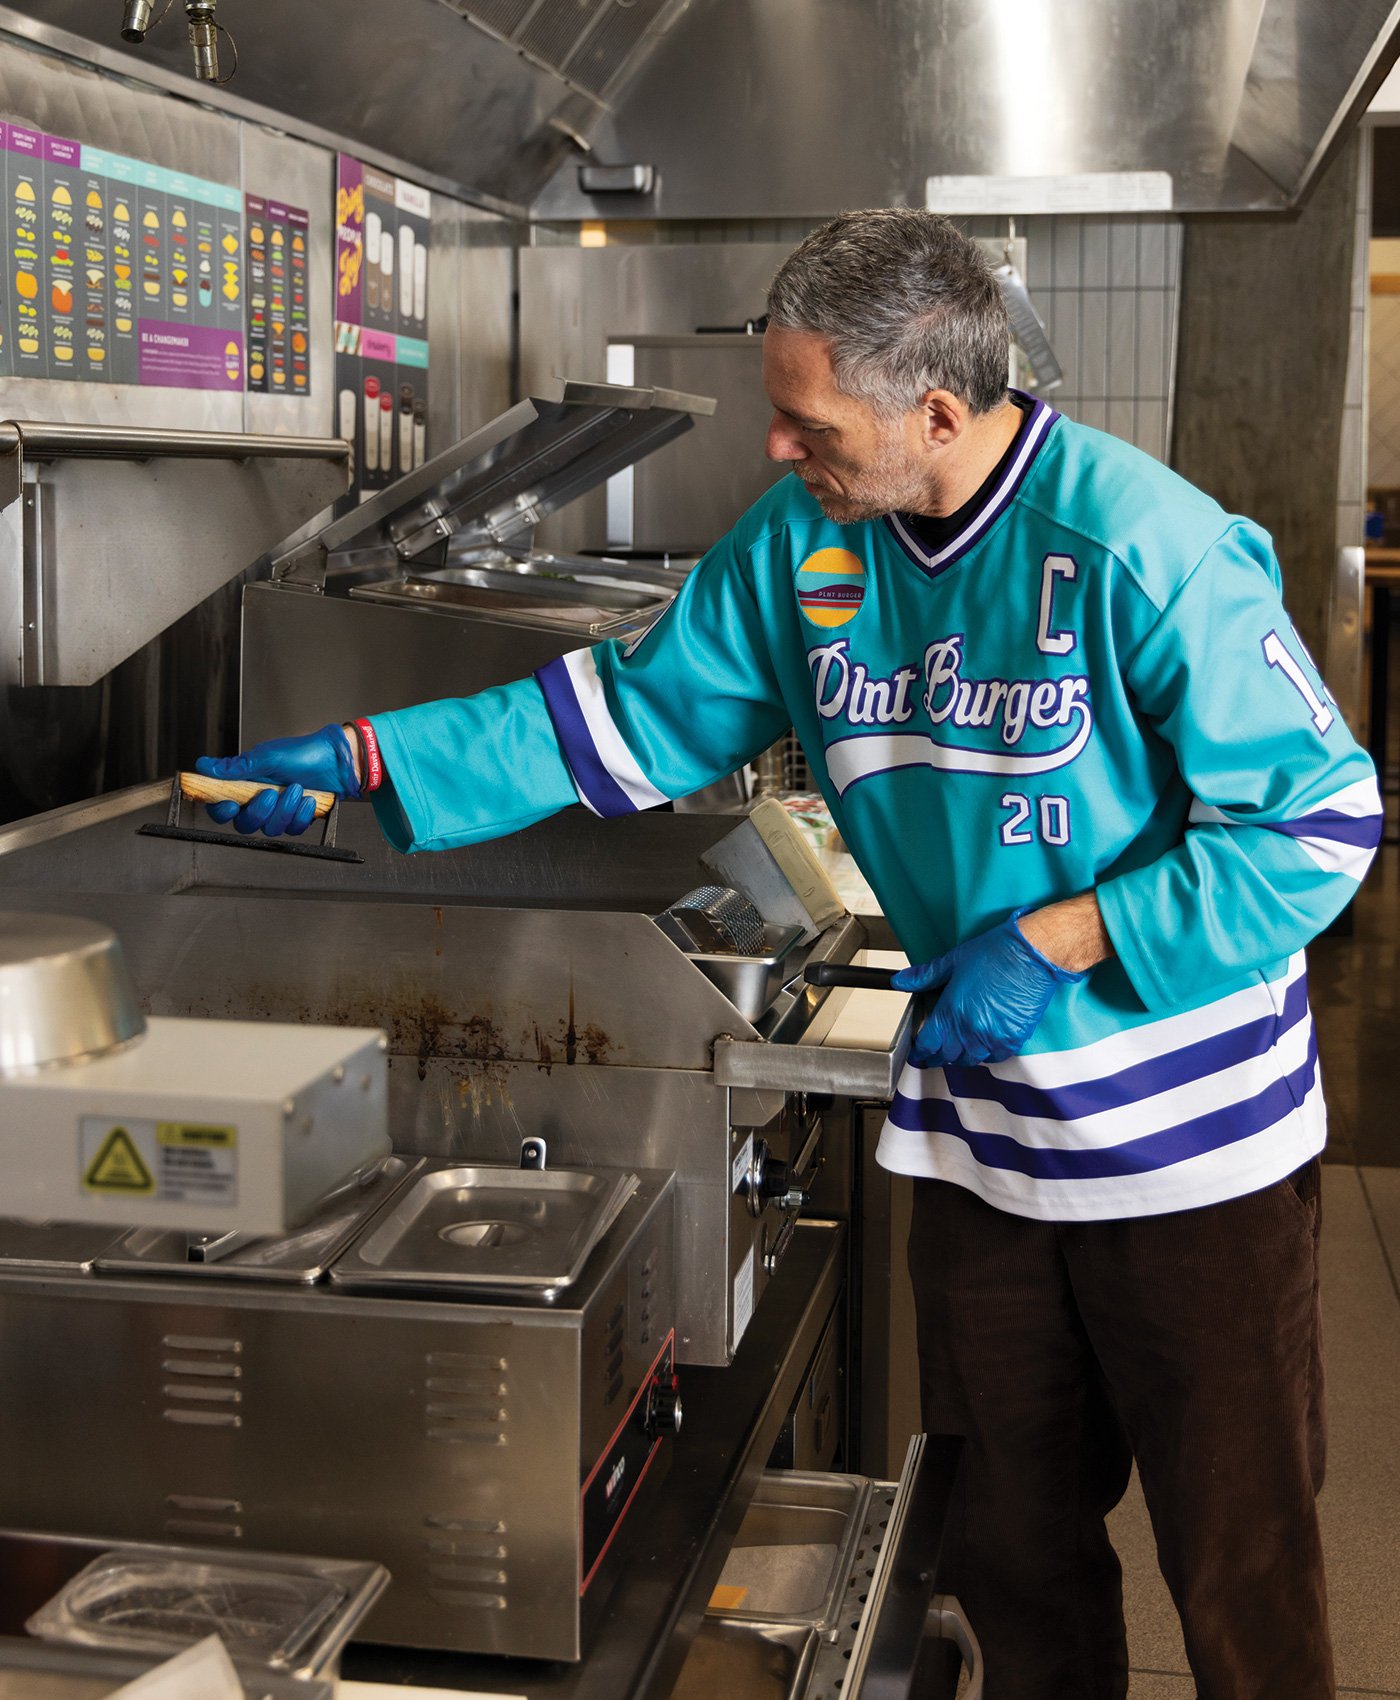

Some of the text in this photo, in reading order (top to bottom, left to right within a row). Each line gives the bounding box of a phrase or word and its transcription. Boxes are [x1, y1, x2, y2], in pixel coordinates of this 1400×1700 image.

[1037, 553, 1078, 656] C
[922, 633, 1090, 746] Burger
[371, 752, 379, 772] Davis
[1000, 792, 1070, 846] 20
